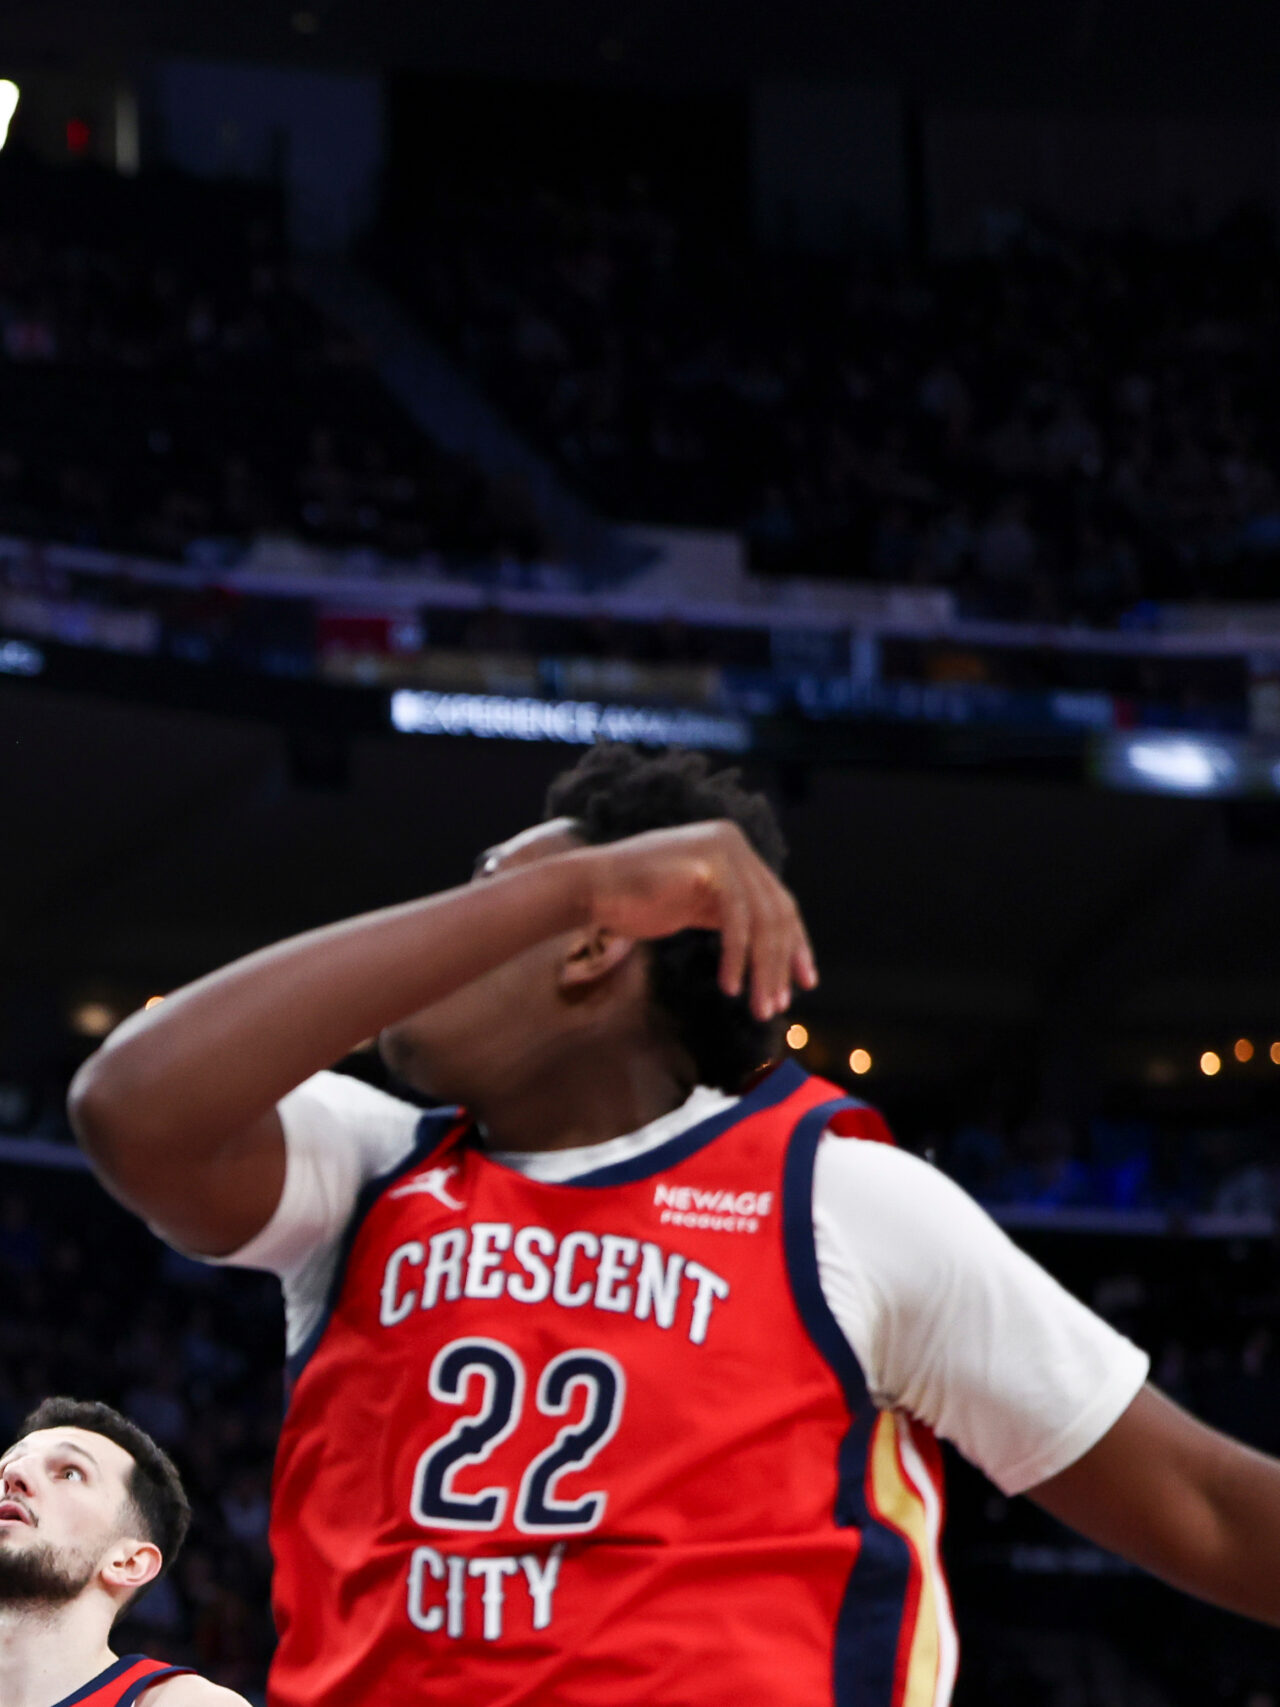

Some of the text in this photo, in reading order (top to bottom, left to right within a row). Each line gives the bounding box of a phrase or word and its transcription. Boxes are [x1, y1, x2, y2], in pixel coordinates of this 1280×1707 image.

[653, 1184, 773, 1217] NEWAGE
[660, 1209, 759, 1234] PRODUCTS
[379, 1222, 730, 1345] CRESCENT
[410, 1337, 626, 1534] 22
[407, 1542, 566, 1641] CITY
